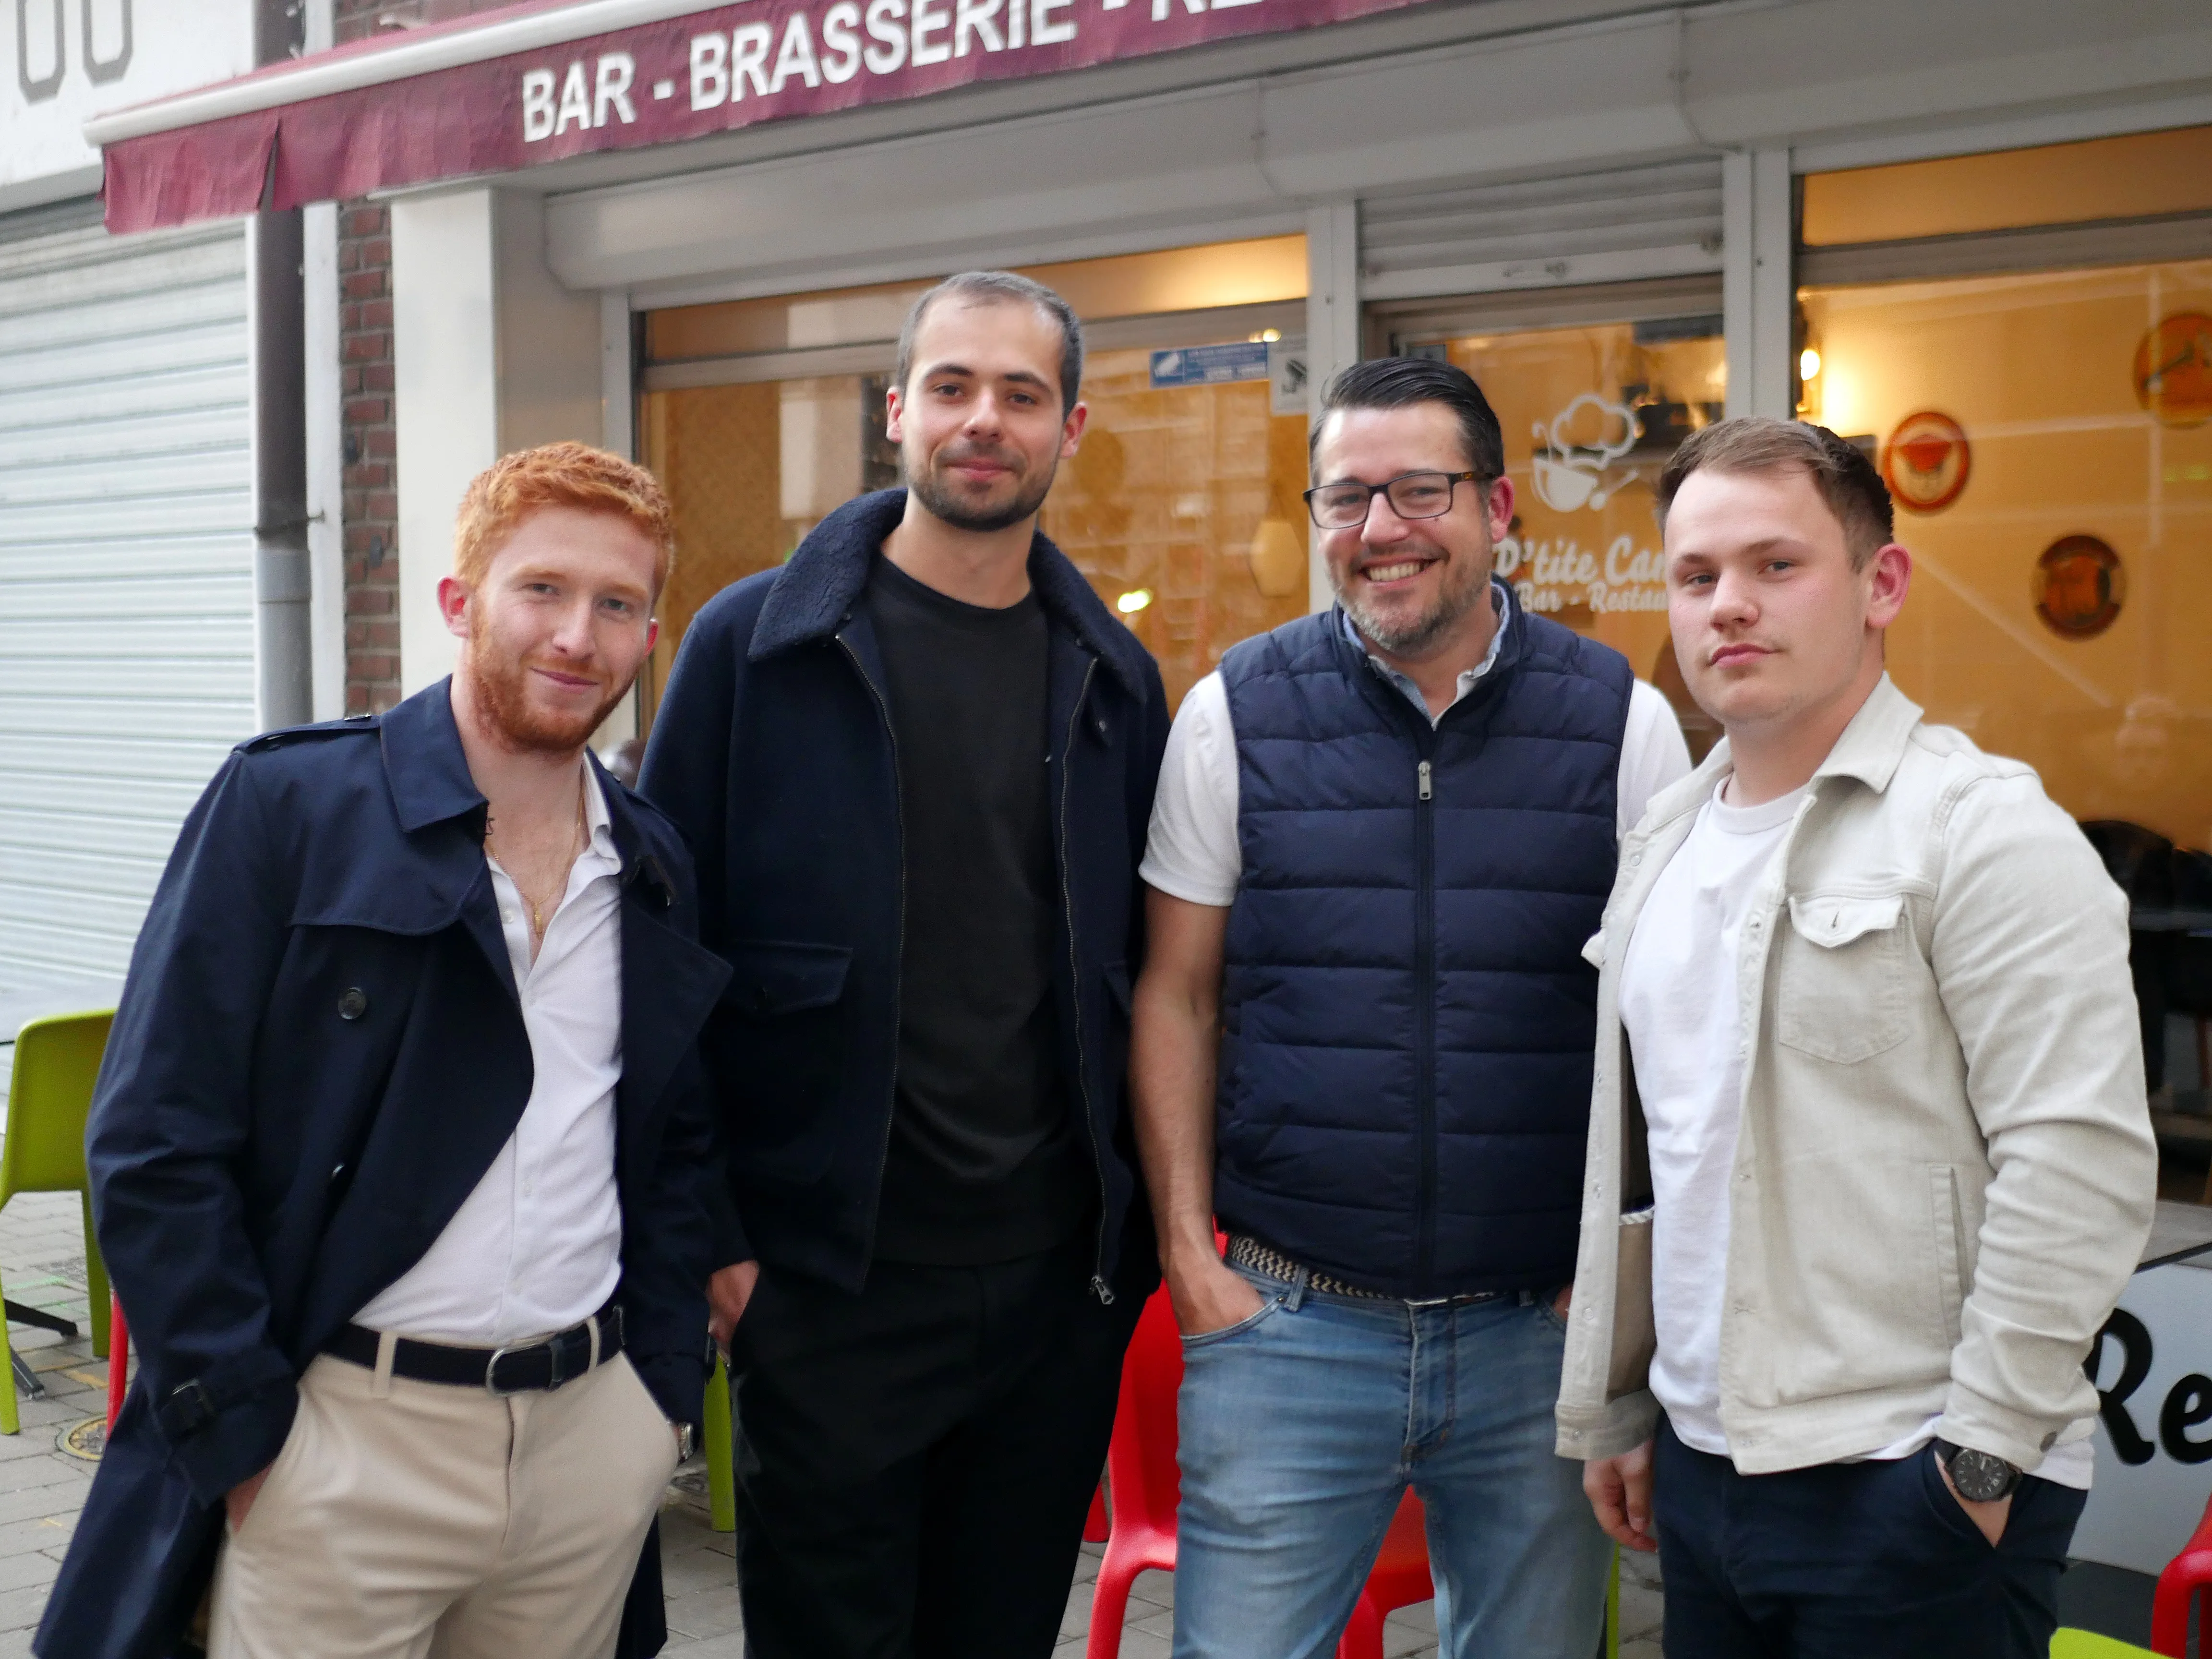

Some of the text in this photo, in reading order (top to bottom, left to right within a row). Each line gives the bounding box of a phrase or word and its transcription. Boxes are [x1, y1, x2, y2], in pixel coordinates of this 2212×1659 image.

[522, 51, 636, 143] BAR
[689, 0, 1077, 111] BRASSERIE
[1514, 580, 1563, 613] Bar
[2081, 1307, 2212, 1466] Re
